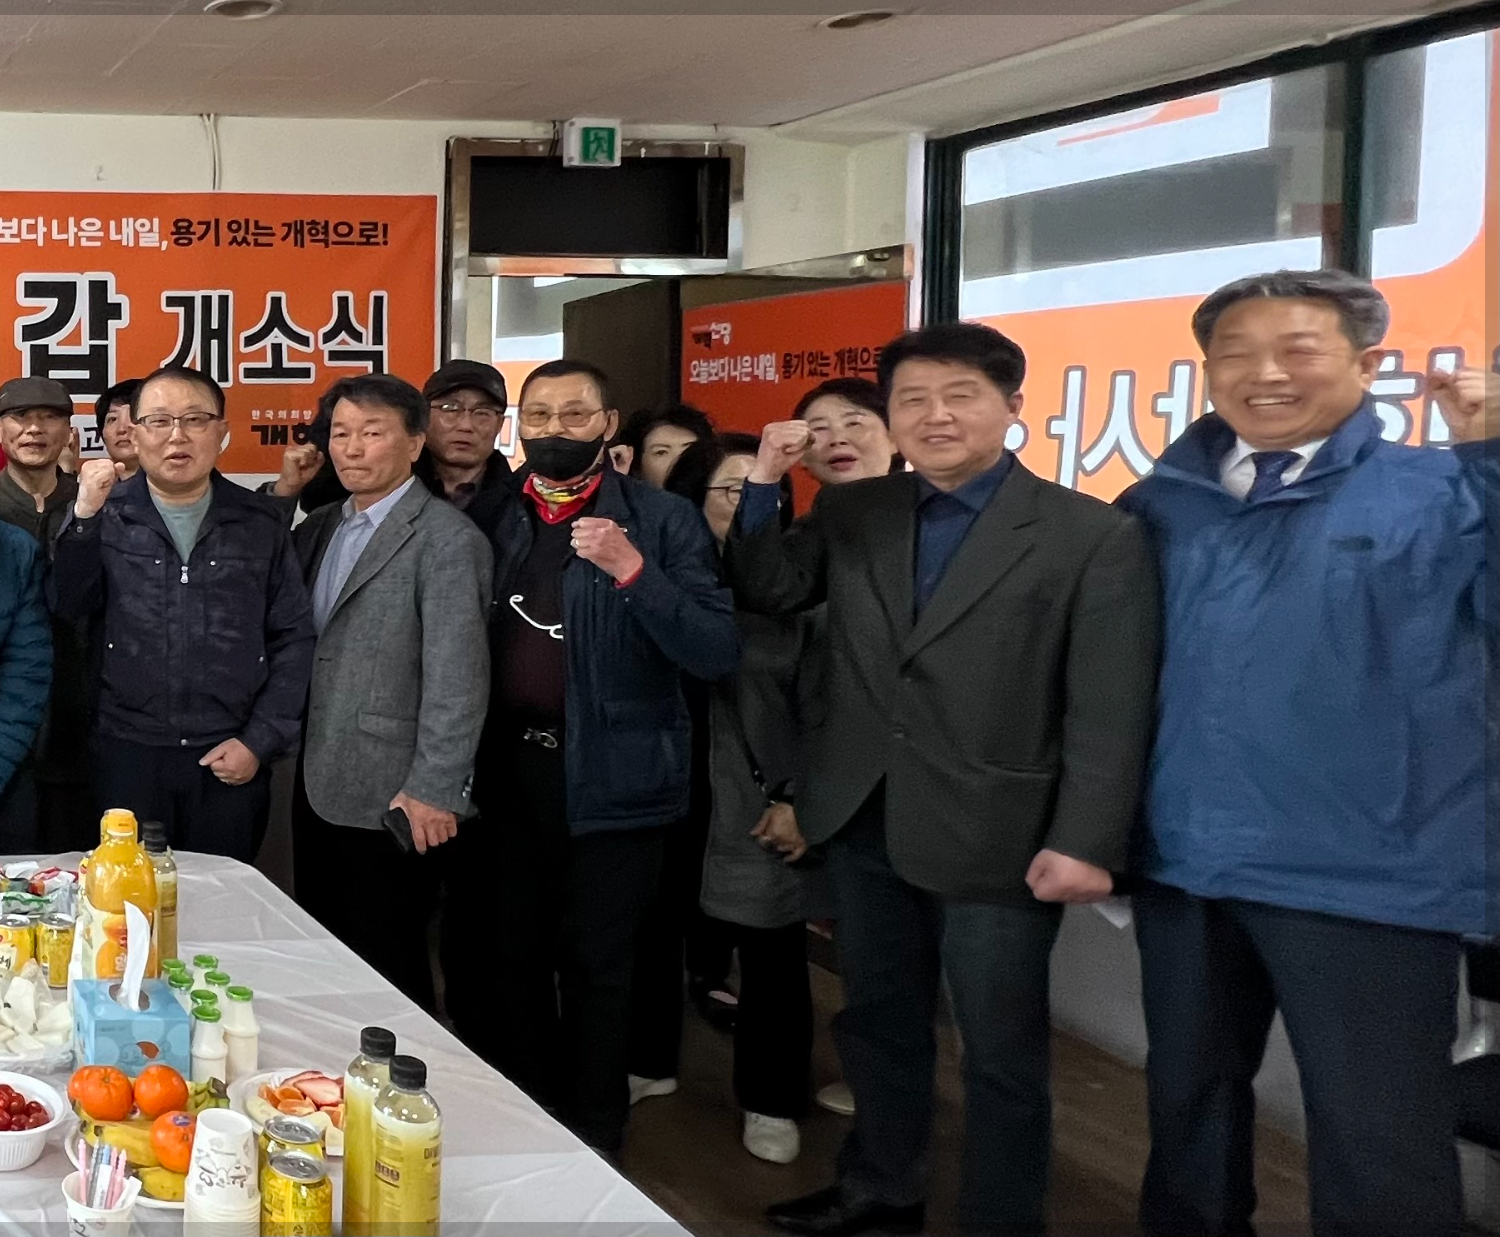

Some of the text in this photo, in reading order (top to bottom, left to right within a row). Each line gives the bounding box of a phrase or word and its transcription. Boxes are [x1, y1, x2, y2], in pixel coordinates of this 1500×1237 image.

[52, 216, 104, 248] 나은
[109, 216, 169, 253] 내일,
[170, 218, 221, 249] 용기
[227, 218, 277, 249] 있는
[281, 218, 389, 250] 개혁으로!
[161, 289, 389, 386] 개소식
[689, 354, 729, 385] 오늘보다
[730, 354, 751, 383] 나은
[754, 352, 779, 384] 내일,
[782, 350, 805, 380] 용기
[807, 349, 831, 378] 있는
